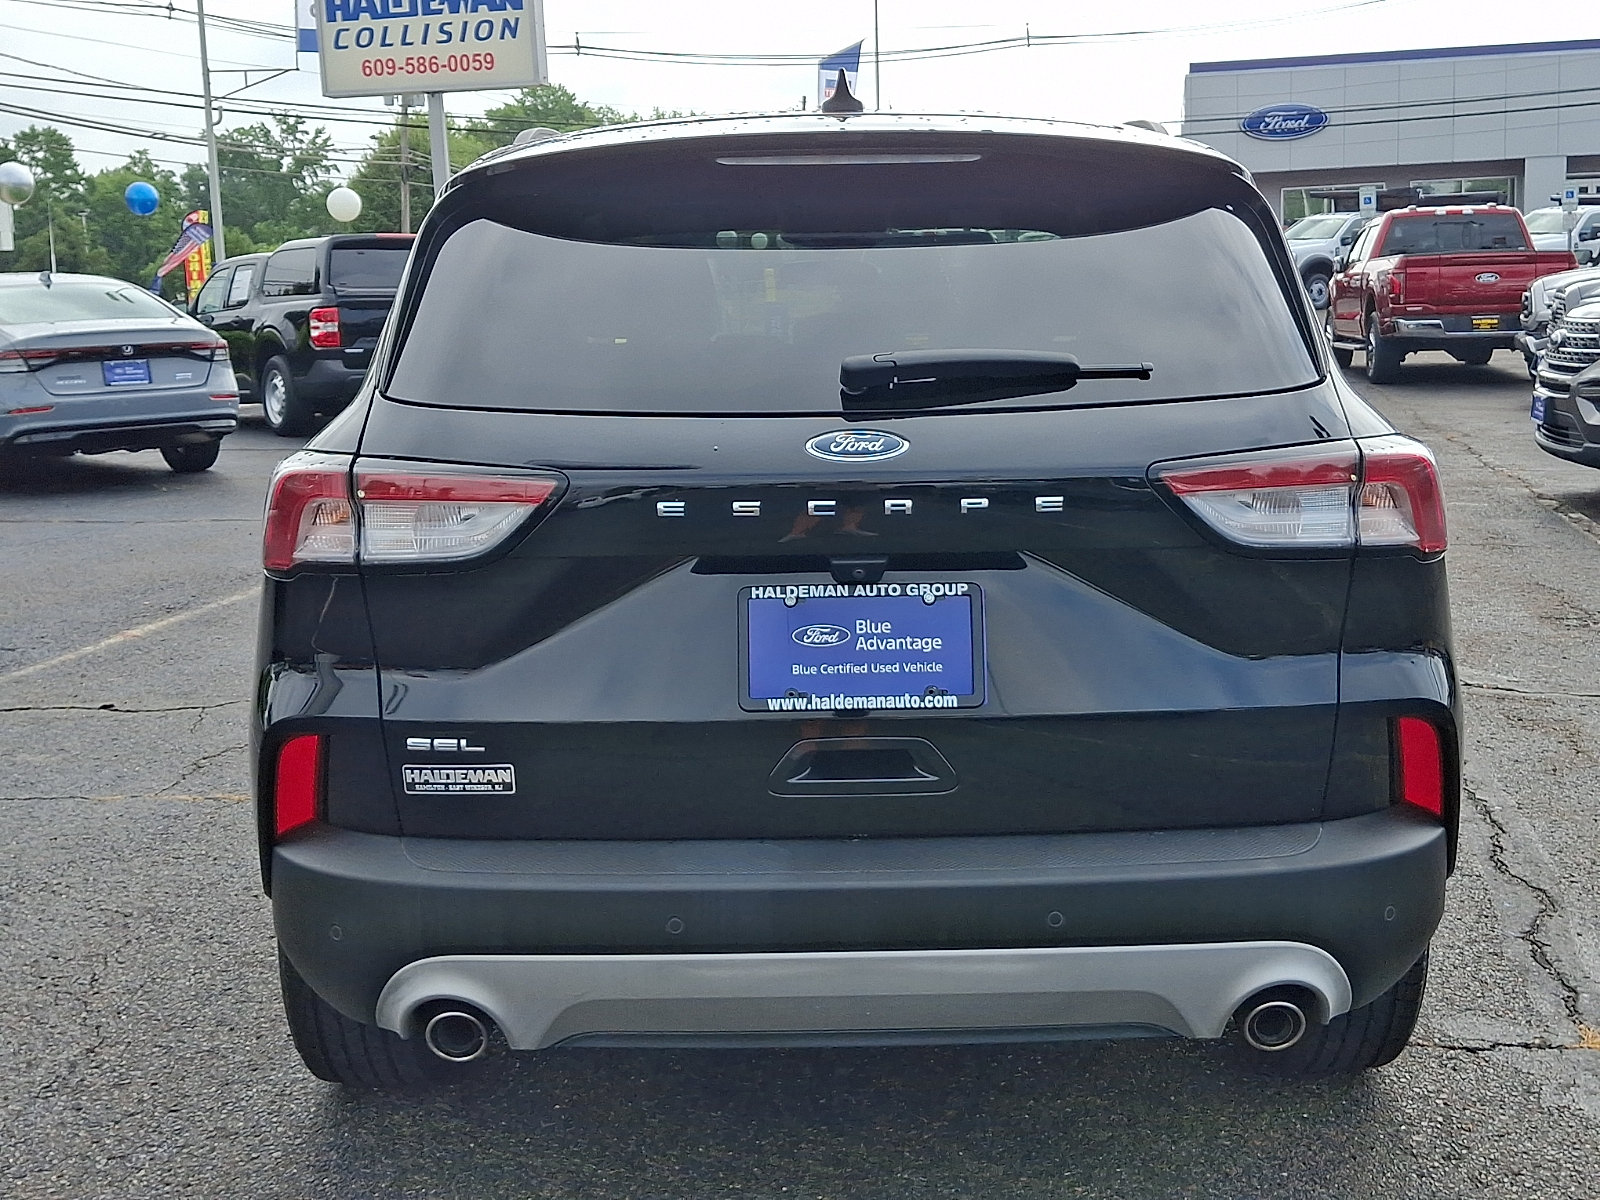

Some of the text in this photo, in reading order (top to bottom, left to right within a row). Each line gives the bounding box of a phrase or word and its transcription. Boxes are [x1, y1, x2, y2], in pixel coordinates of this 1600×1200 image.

[333, 17, 520, 50] COLLISION
[361, 52, 495, 77] 609-586-0059
[1260, 111, 1310, 133] Ford
[830, 434, 885, 452] Ford
[656, 495, 1064, 517] ESCAPE
[751, 583, 969, 599] HALDEMAN AUTO GROUP
[855, 619, 892, 634] Blue
[803, 627, 839, 643] Ford
[855, 636, 942, 652] Advantage
[792, 661, 943, 675] Blue Certified Used Vehicle
[767, 693, 958, 711] www.haldemanauto.com
[406, 737, 485, 751] SEL
[405, 769, 512, 783] HALDEMAN
